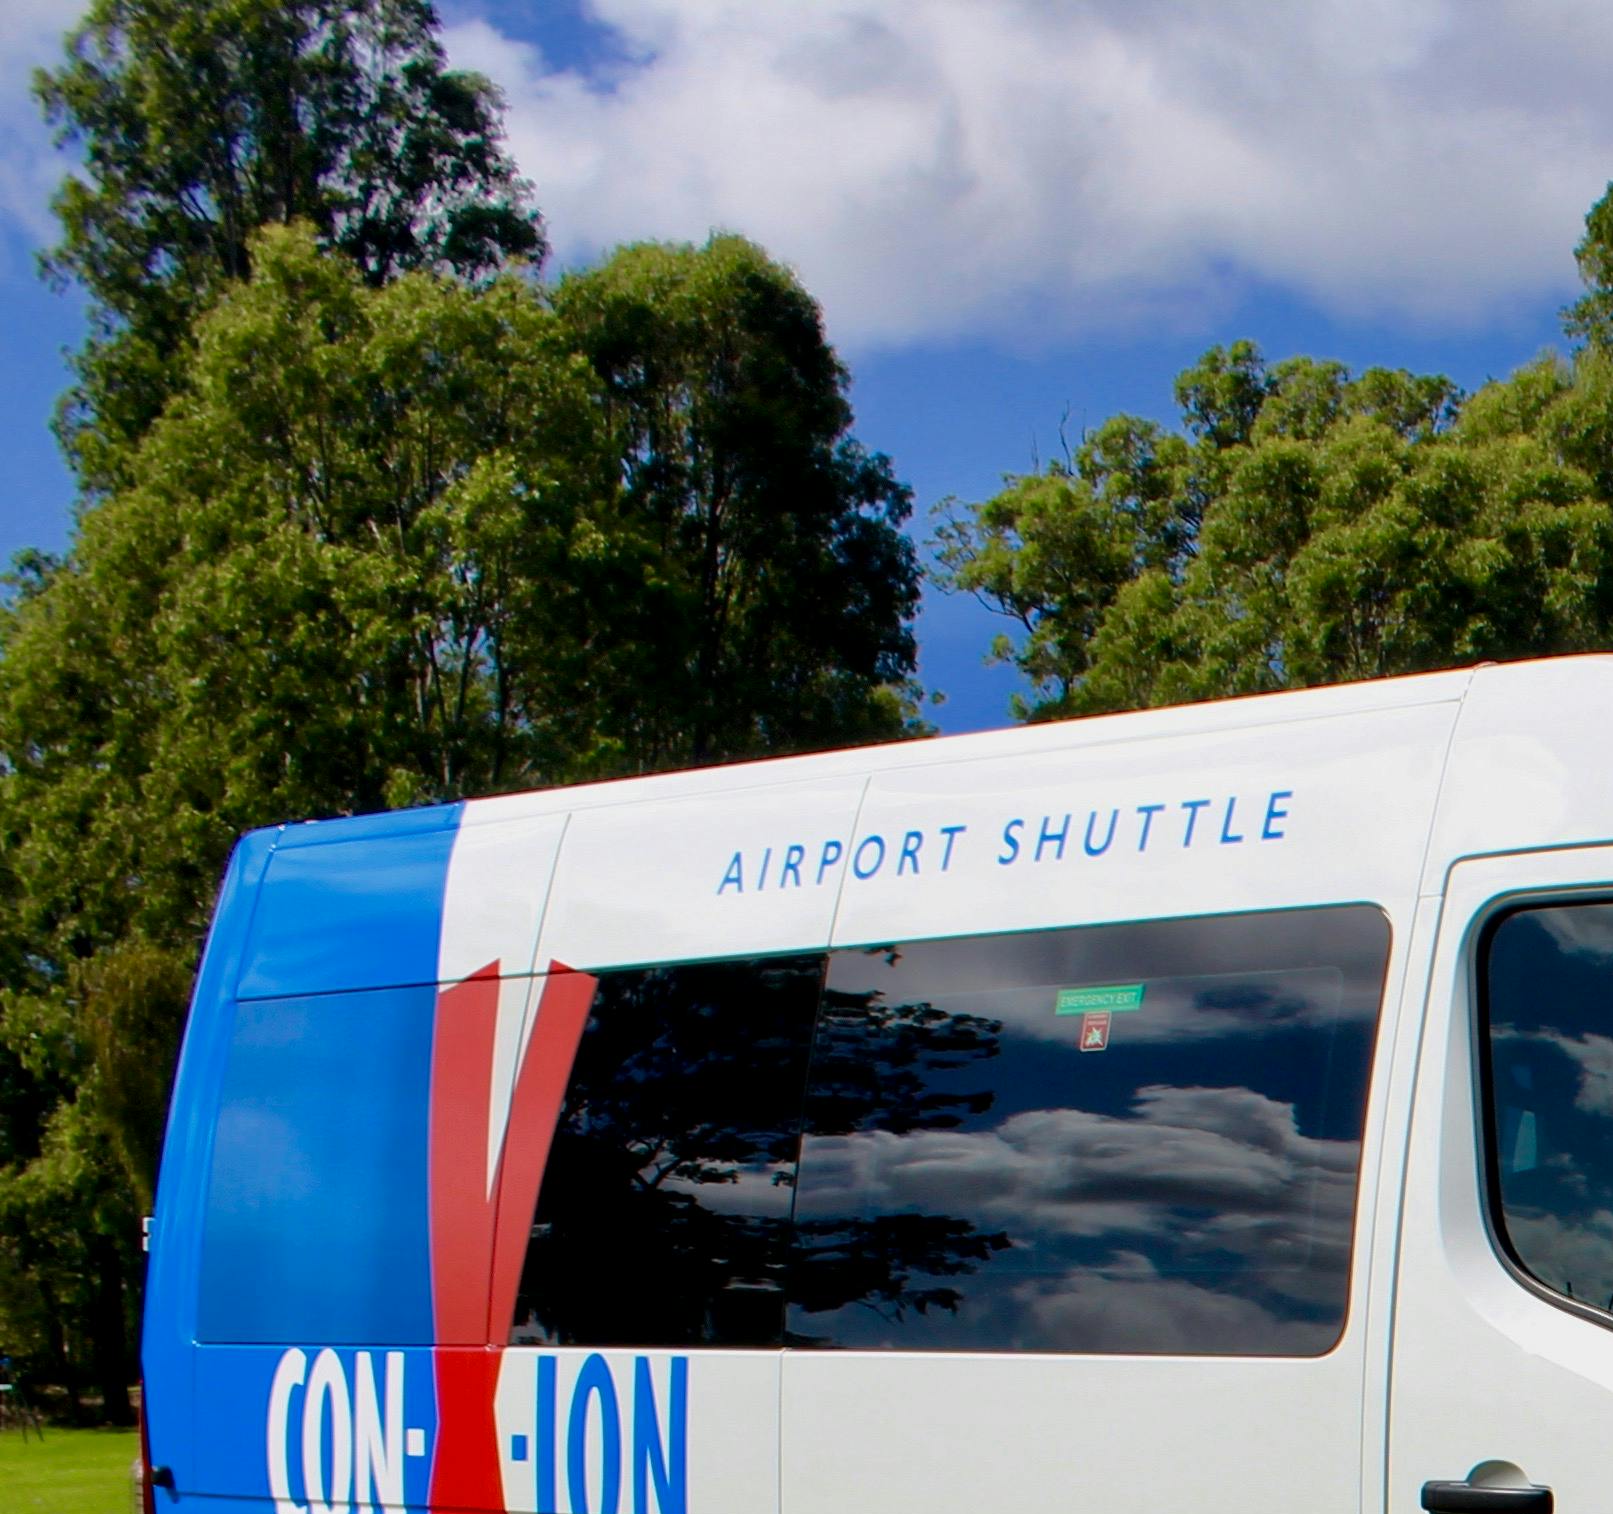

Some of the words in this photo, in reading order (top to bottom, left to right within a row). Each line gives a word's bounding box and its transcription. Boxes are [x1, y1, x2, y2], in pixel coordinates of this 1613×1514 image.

[716, 824, 967, 896] AIRPORT
[997, 790, 1294, 867] SHUTTLE
[1060, 993, 1115, 1008] EMERGENCY
[1116, 991, 1137, 1005] EXIT
